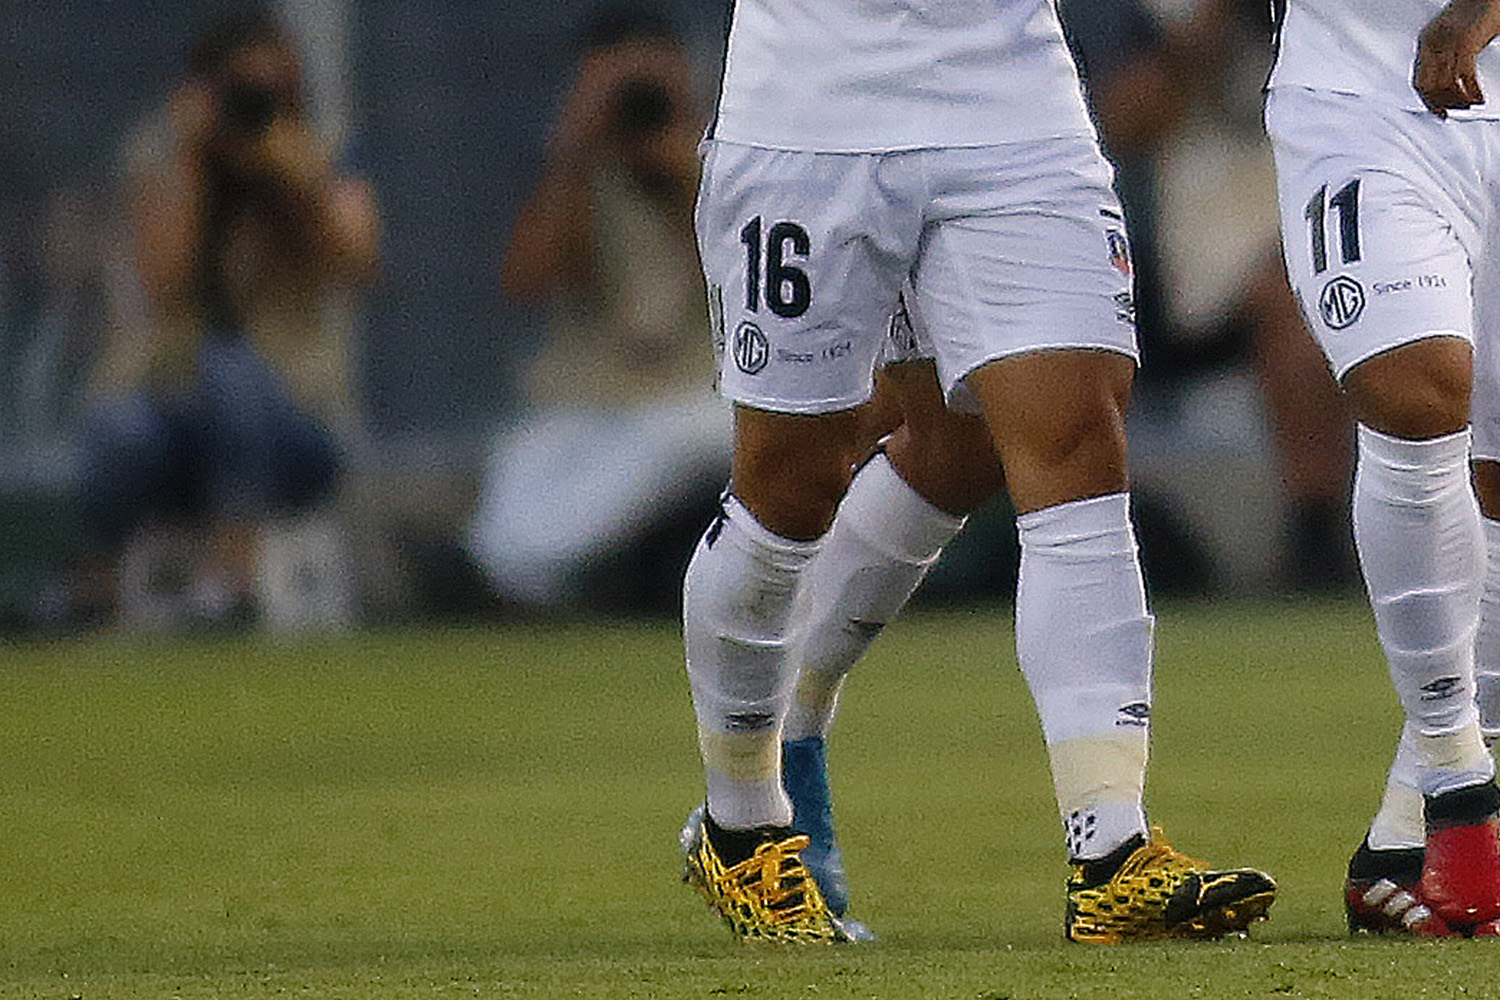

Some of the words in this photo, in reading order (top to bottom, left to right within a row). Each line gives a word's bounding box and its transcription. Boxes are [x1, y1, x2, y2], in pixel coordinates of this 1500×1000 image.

[1305, 178, 1362, 274] 11
[740, 215, 811, 317] 16
[1322, 281, 1361, 326] MG
[735, 325, 767, 371] MG
